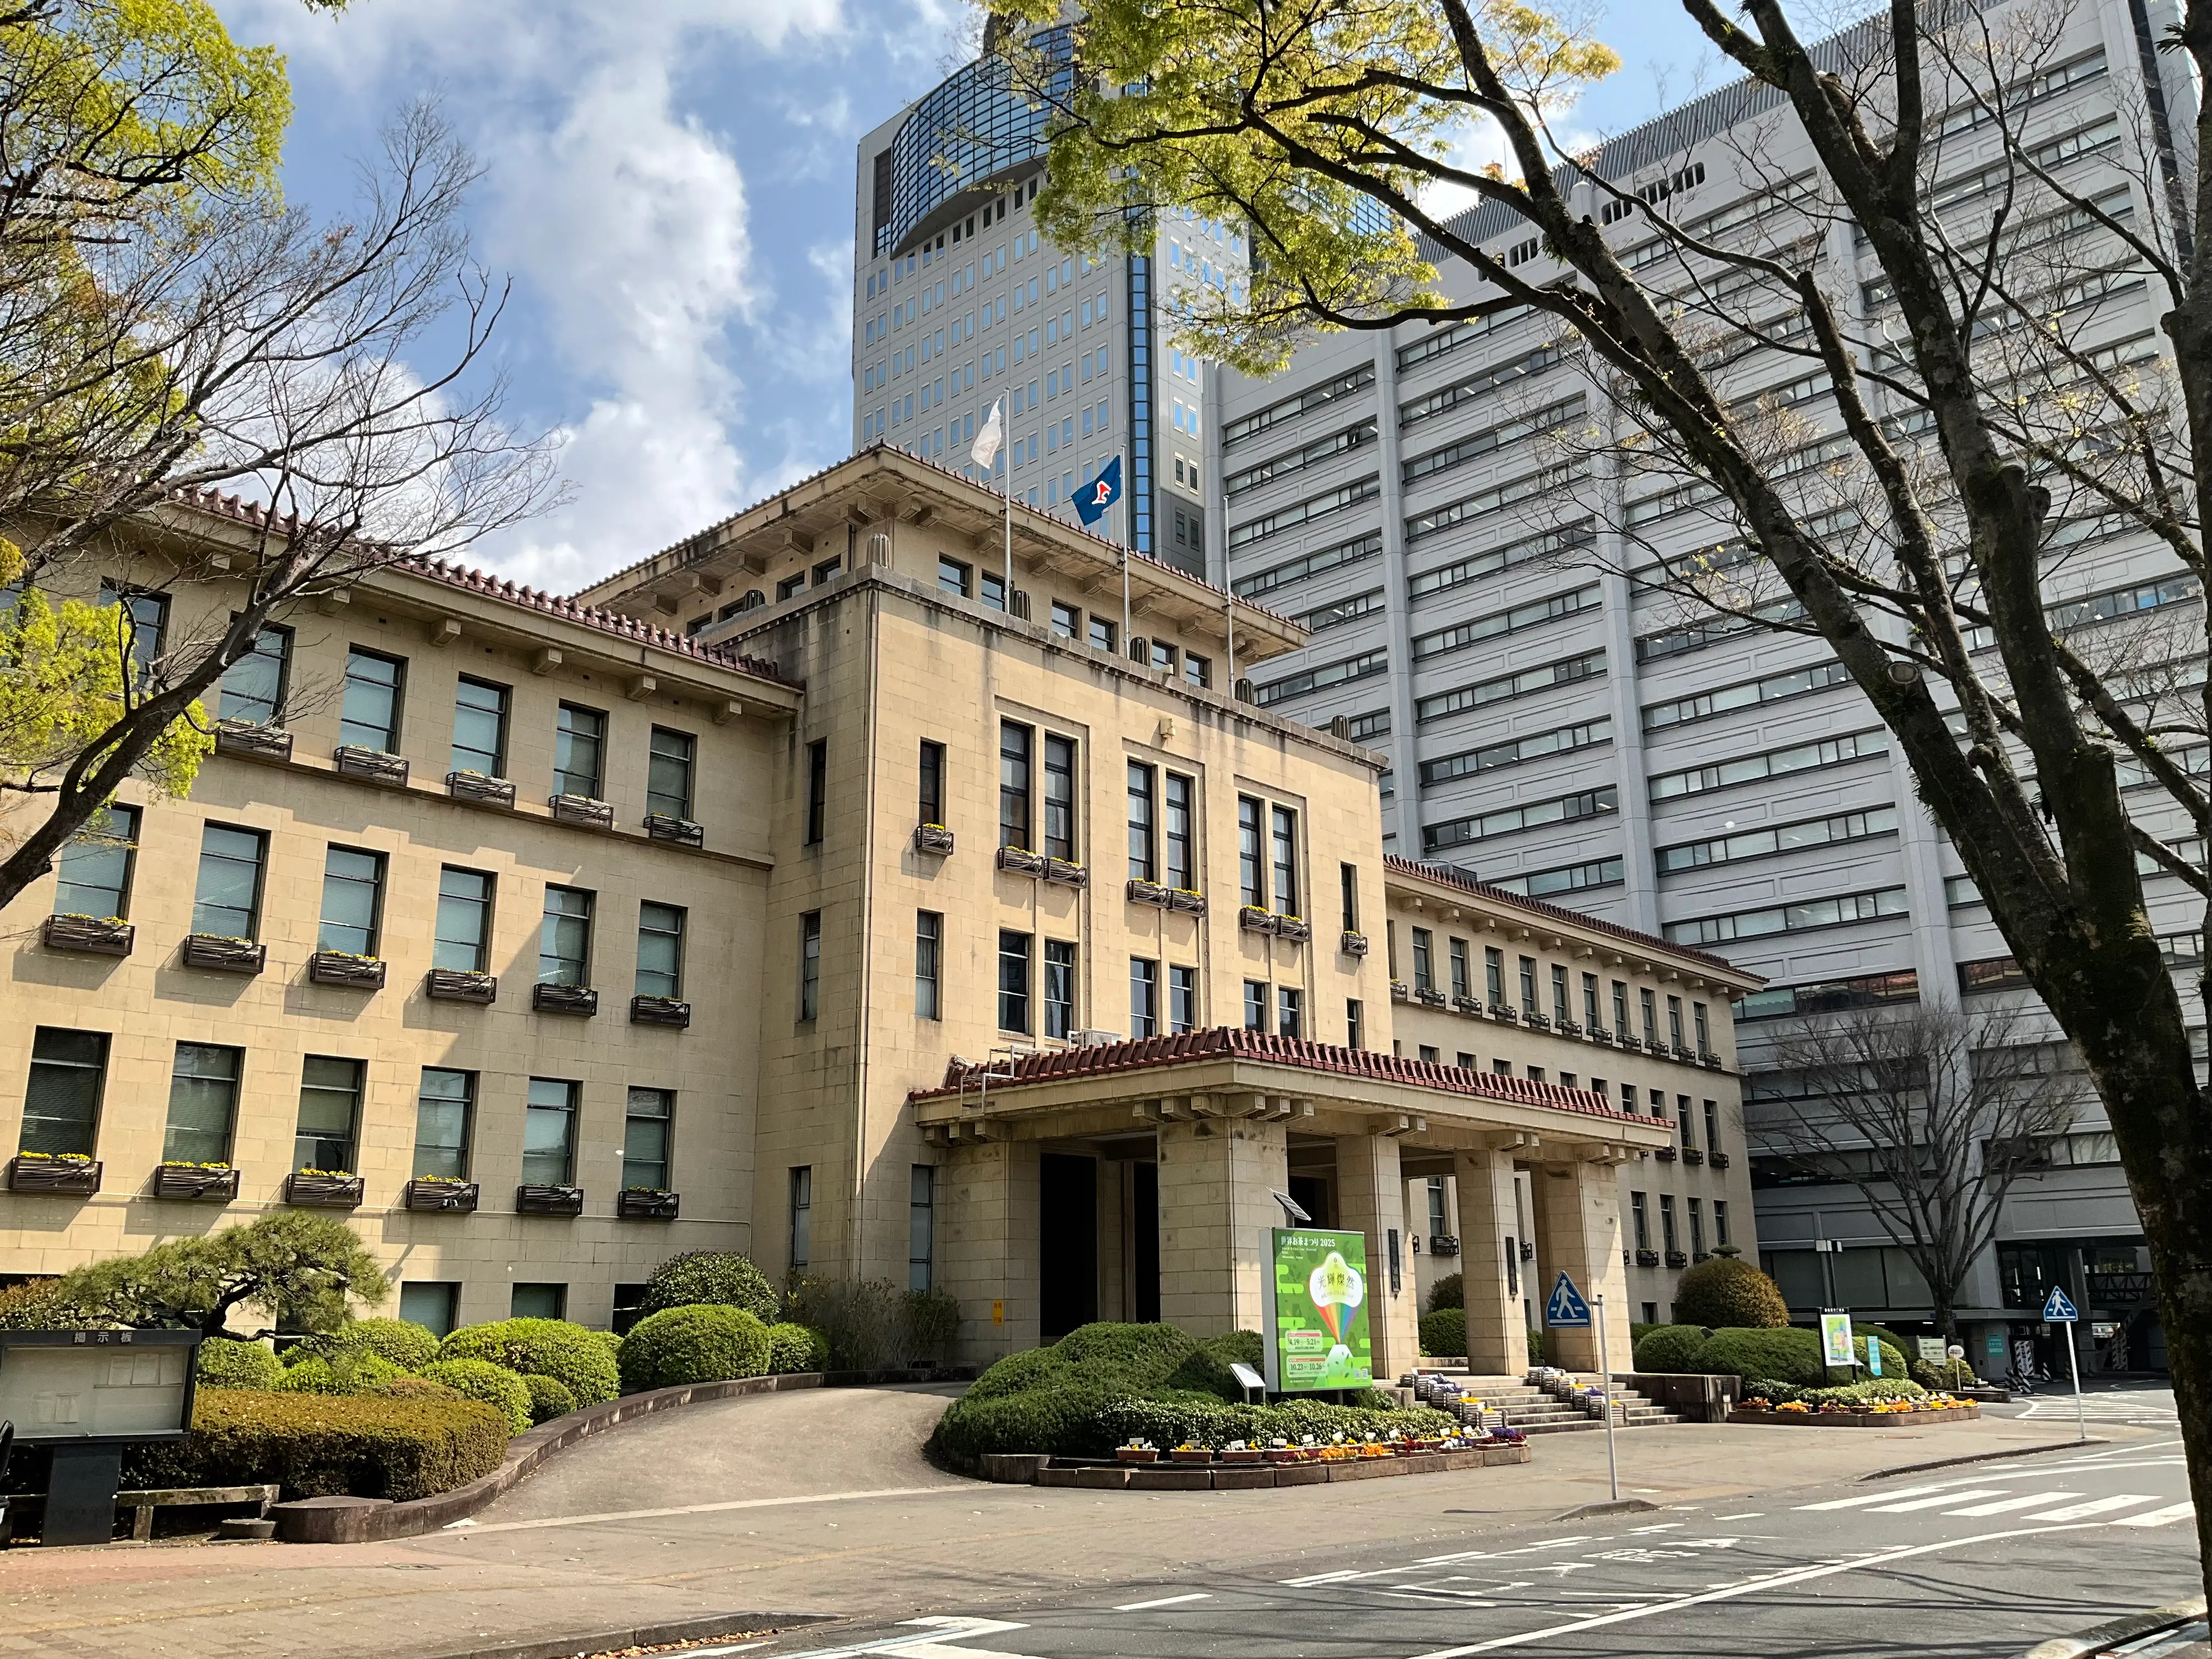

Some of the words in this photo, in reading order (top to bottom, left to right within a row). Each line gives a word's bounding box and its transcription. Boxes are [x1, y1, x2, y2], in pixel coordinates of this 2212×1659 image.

[1281, 1235, 1318, 1246] 世界お茶まつり
[1320, 1238, 1335, 1247] 2025
